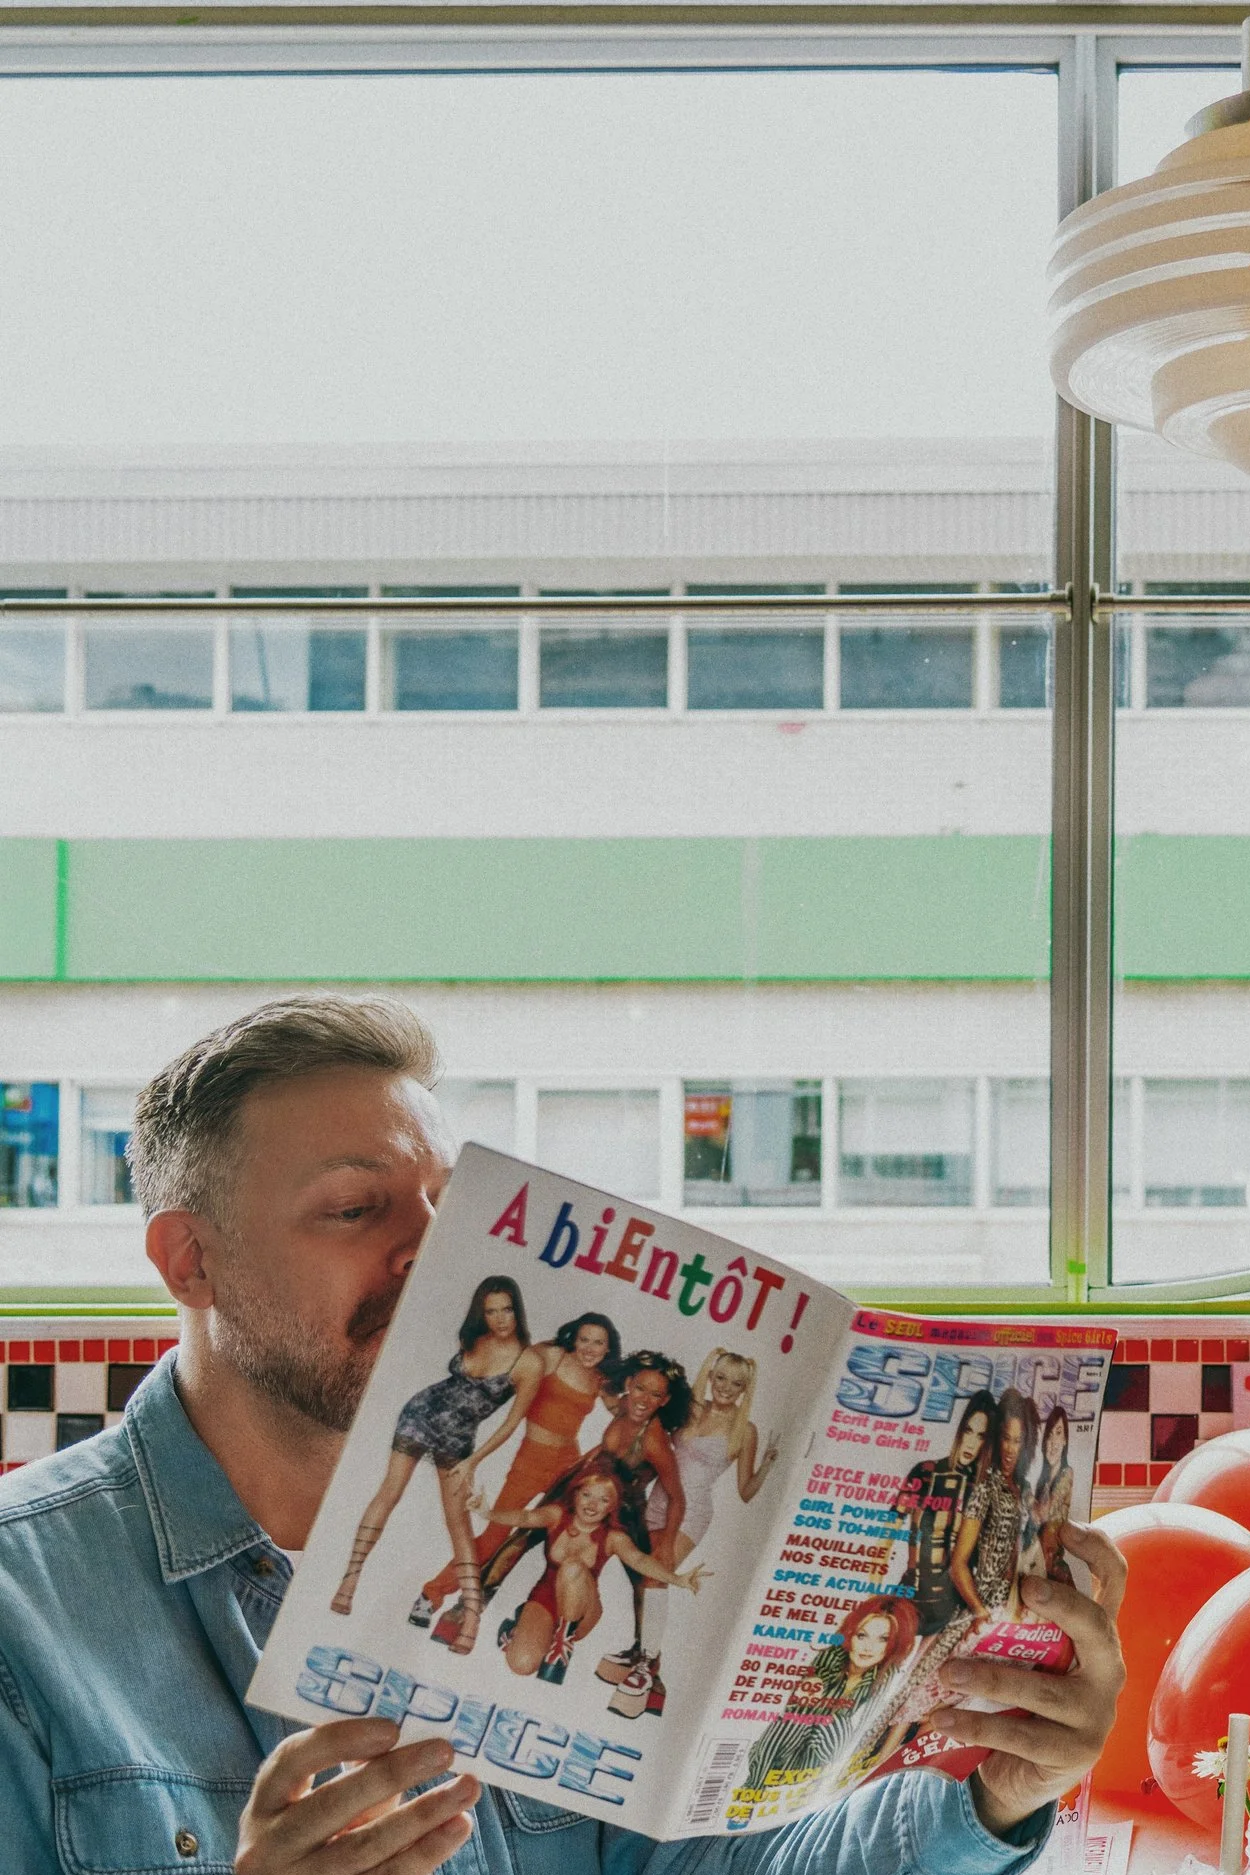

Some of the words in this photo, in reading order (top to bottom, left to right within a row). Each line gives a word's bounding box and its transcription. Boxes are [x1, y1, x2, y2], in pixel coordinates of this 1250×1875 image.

[490, 1181, 529, 1248] A
[783, 1293, 812, 1354] !
[856, 1316, 880, 1331] Le
[836, 1344, 1106, 1423] SPICE
[832, 1409, 870, 1428] Ecrit
[873, 1418, 897, 1433] par
[902, 1420, 926, 1436] les
[826, 1425, 871, 1446] Spice
[875, 1433, 910, 1450] Girls
[811, 1463, 865, 1485] SPICE
[867, 1472, 923, 1492] WORLD
[806, 1477, 832, 1496] UN
[834, 1481, 921, 1509] TOURNAGE
[799, 1498, 836, 1515] GIRL
[840, 1503, 899, 1523] POWER
[793, 1514, 832, 1531] SOIS
[786, 1533, 888, 1559] MAQUILLAGE
[779, 1549, 815, 1566] NOS
[818, 1553, 890, 1577] SECRETS
[773, 1568, 823, 1588] SPICE
[766, 1588, 797, 1604] LES
[760, 1604, 783, 1619] DE
[786, 1608, 819, 1624] MEL
[823, 1612, 839, 1627] B.
[752, 1624, 815, 1644] KARATE
[818, 1630, 846, 1647] KID
[996, 1622, 1063, 1644] L'adieu
[745, 1642, 799, 1661] INEDIT
[988, 1639, 1004, 1653] à
[1007, 1643, 1050, 1660] Geri
[740, 1659, 762, 1673] 80
[735, 1675, 759, 1689] DE
[761, 1677, 824, 1694] PHOTOS
[728, 1690, 750, 1703] ET
[751, 1692, 783, 1706] DES
[294, 1643, 646, 1810] SPICE
[721, 1707, 780, 1724] ROMAN
[731, 1788, 781, 1803] TOUT
[725, 1804, 753, 1819] DE
